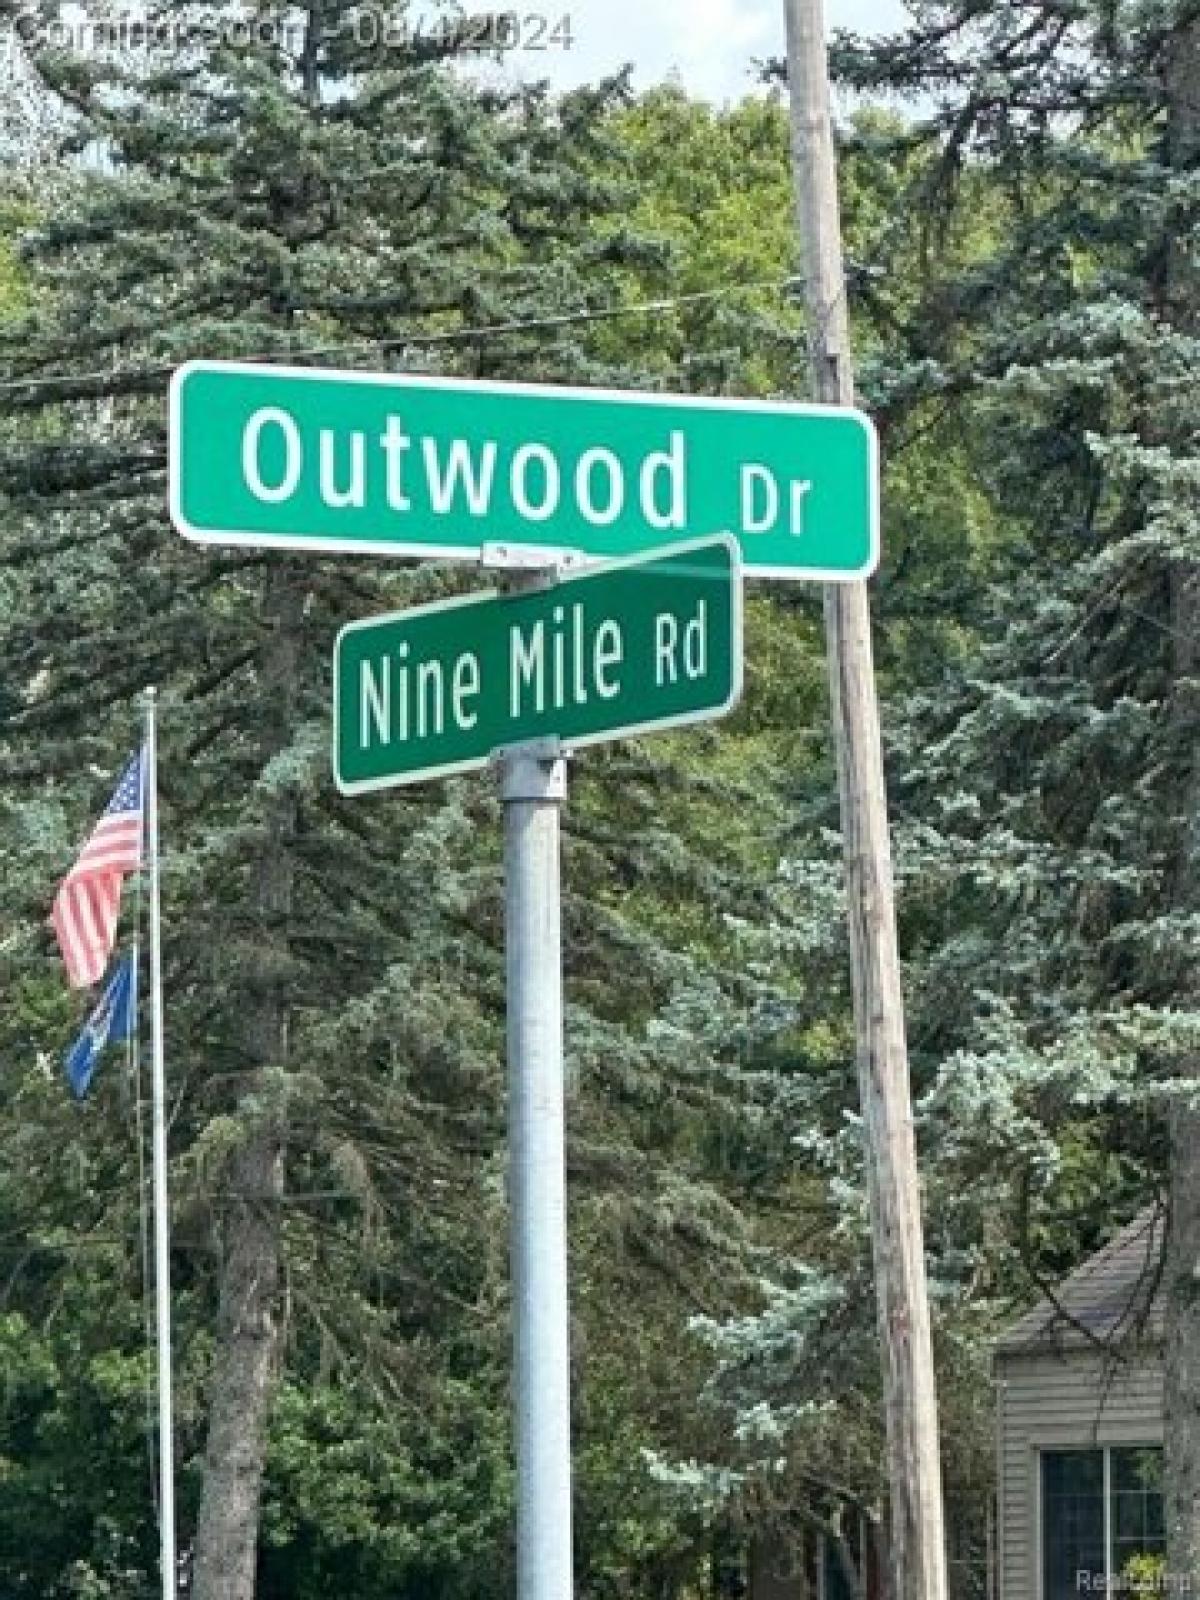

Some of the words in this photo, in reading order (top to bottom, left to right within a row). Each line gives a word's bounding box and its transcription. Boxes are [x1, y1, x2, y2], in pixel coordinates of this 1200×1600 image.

[241, 405, 686, 529] Outwood
[741, 464, 812, 535] Dr
[361, 641, 479, 749] Nine
[511, 604, 622, 718] Mile
[655, 598, 706, 685] Rd
